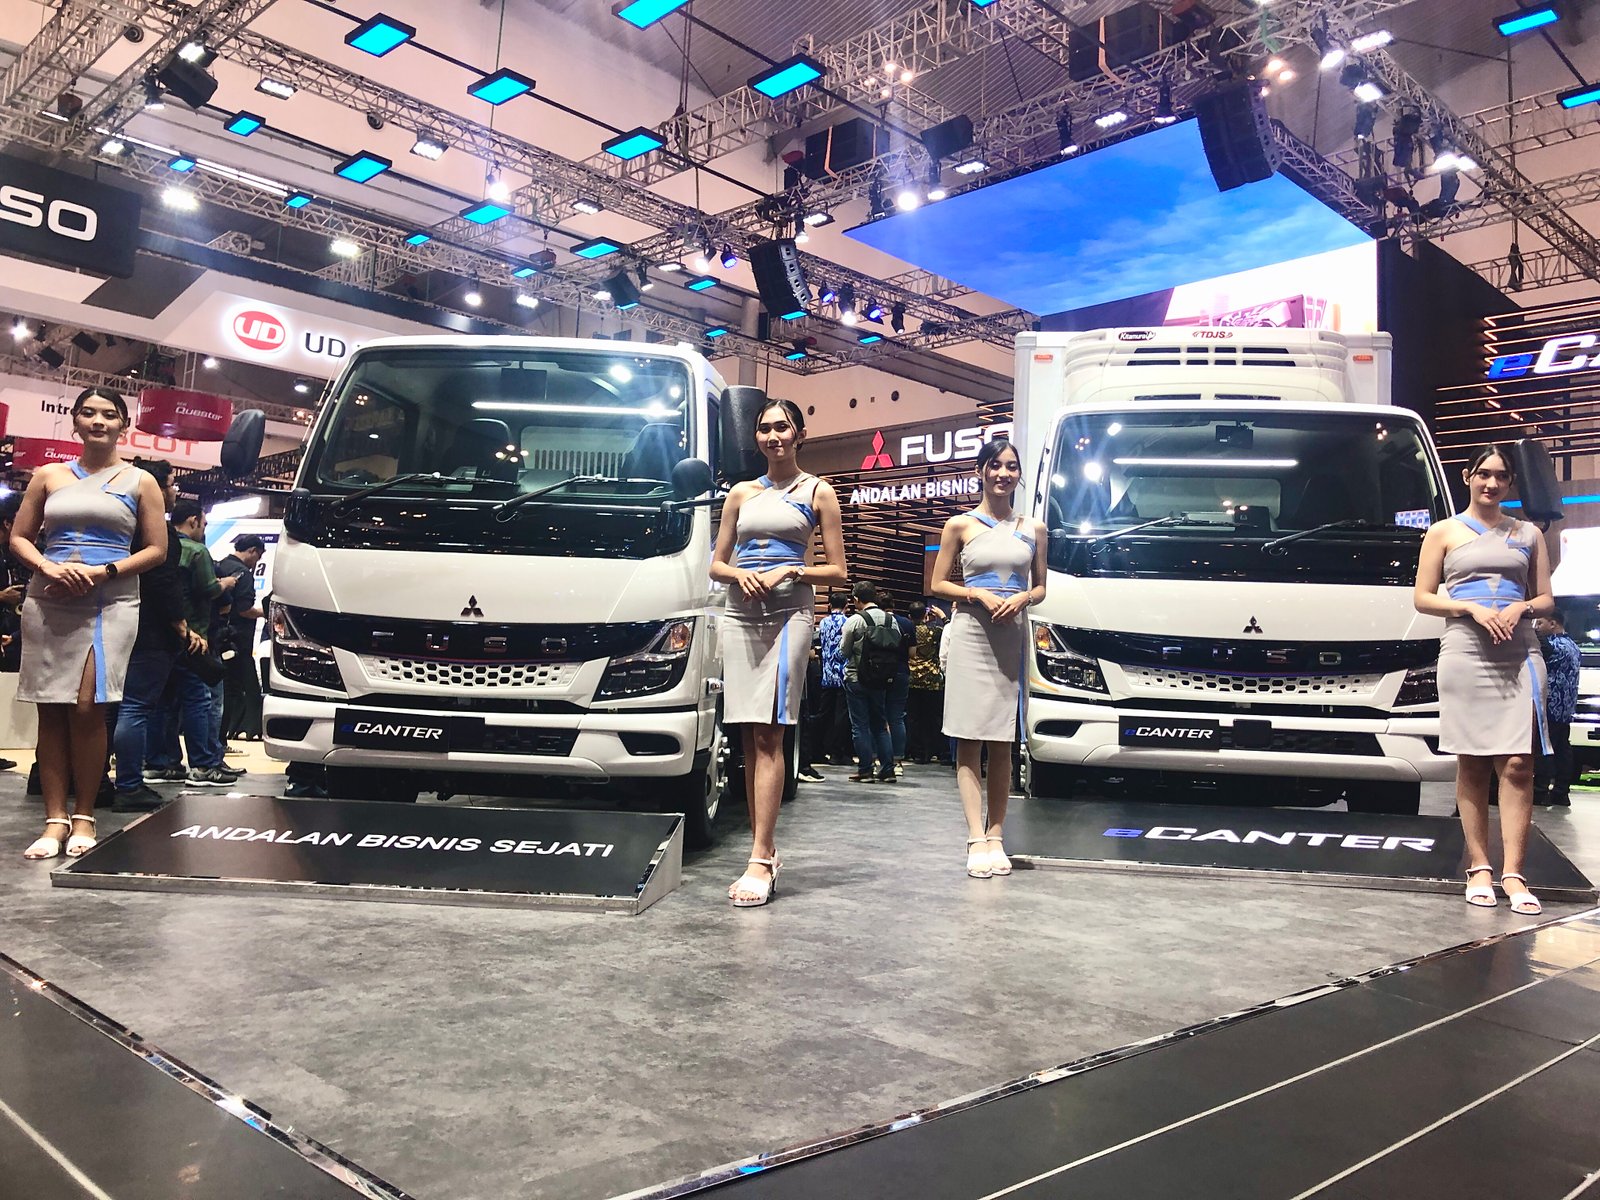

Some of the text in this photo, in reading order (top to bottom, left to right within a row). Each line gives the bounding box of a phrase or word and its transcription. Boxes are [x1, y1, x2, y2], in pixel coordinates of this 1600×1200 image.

[0, 185, 98, 241] SO
[234, 316, 285, 345] UD
[1119, 331, 1151, 341] Kitamura
[1200, 331, 1226, 339] TDJS
[305, 332, 346, 358] UD
[850, 476, 979, 504] ANDALAN BISNIS
[1124, 726, 1214, 739] eCANTER
[170, 824, 615, 858] ANDALAN BISNIS SEJATI
[1102, 826, 1436, 852] eCANTER
